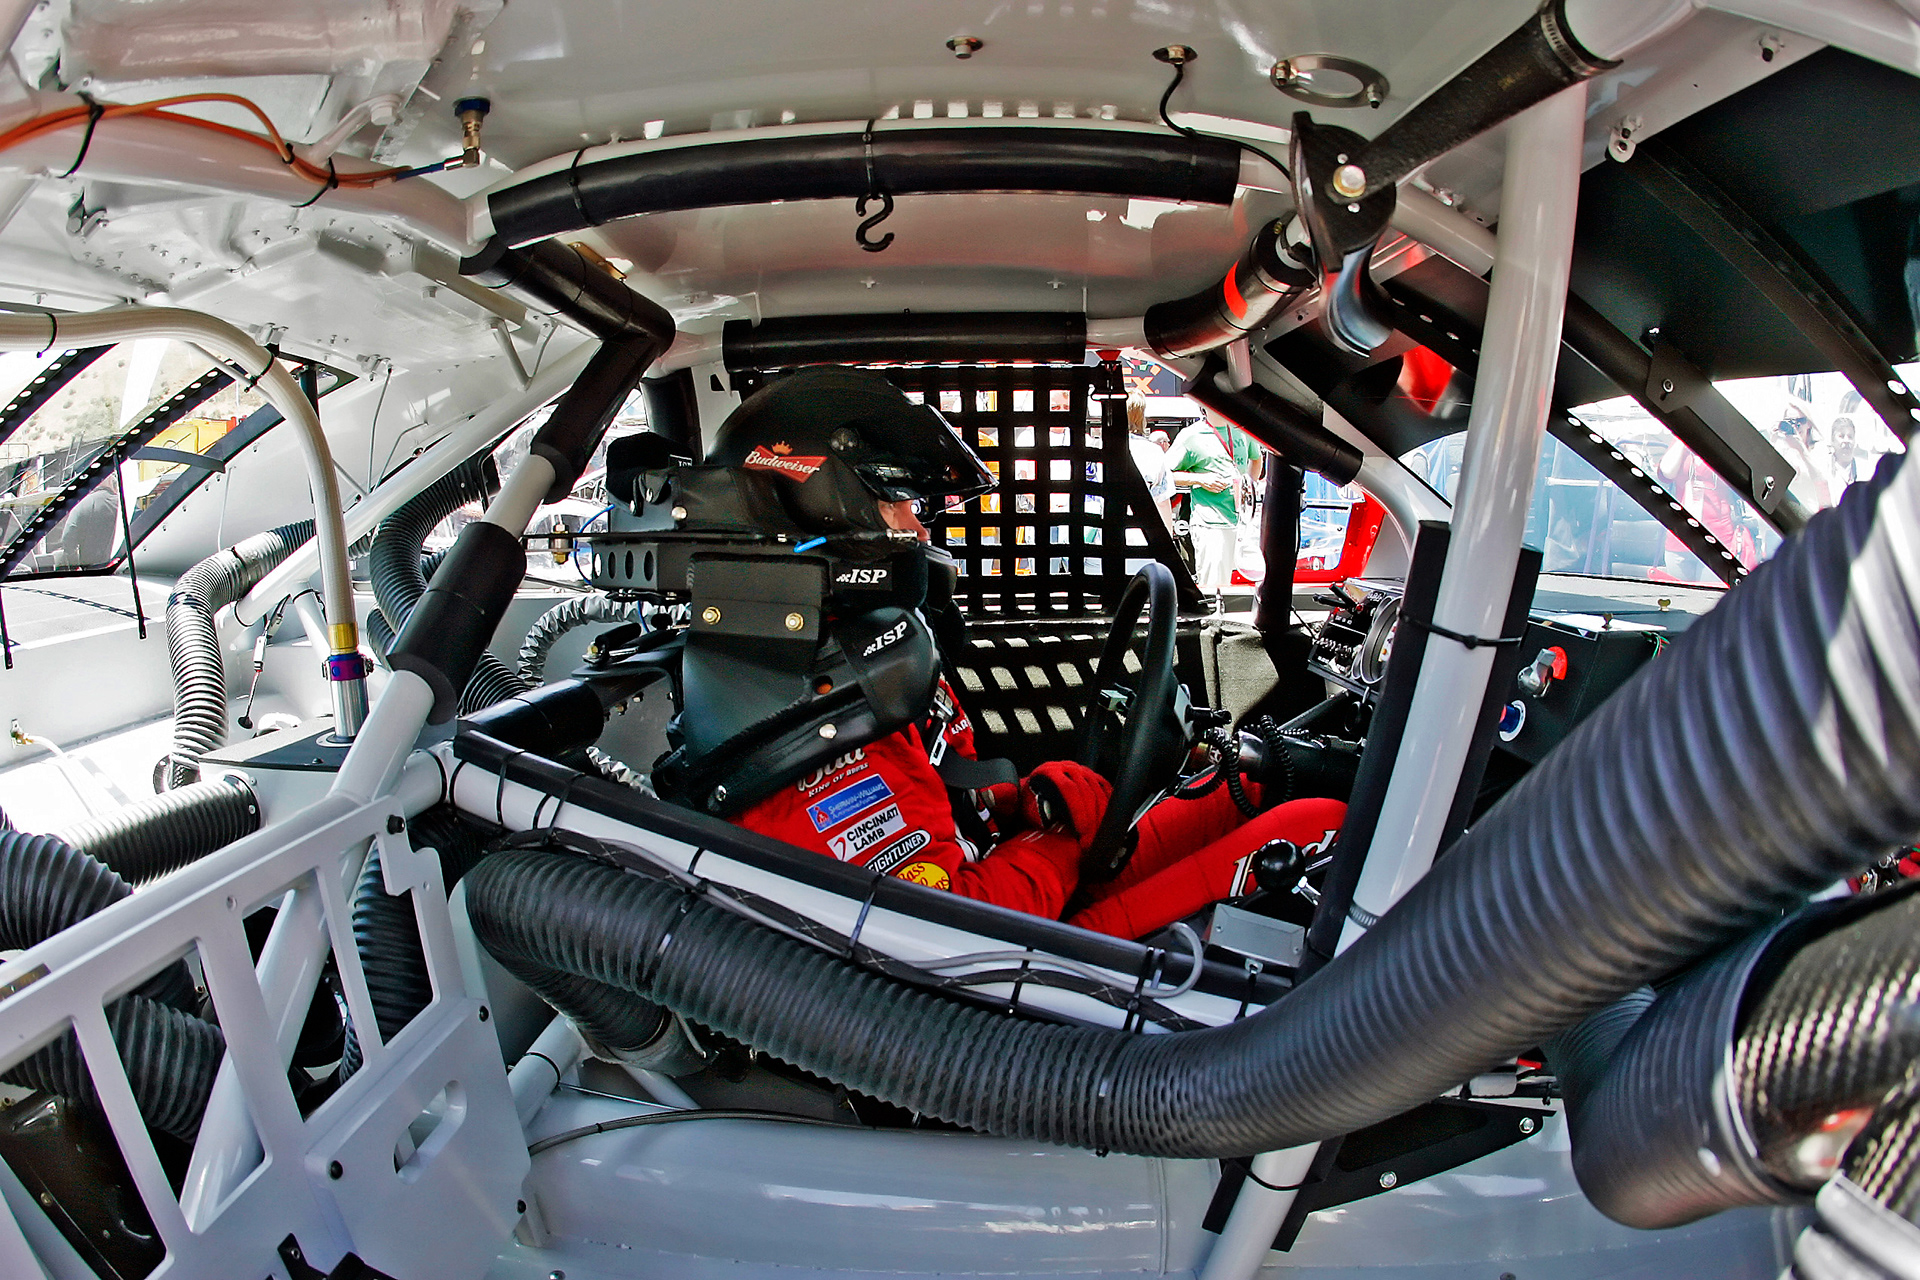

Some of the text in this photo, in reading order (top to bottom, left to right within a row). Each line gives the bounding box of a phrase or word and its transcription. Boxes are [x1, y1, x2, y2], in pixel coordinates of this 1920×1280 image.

[745, 451, 820, 474] Budweiser
[849, 568, 887, 584] ISP
[875, 621, 908, 651] ISP
[853, 827, 886, 852] LAMB
